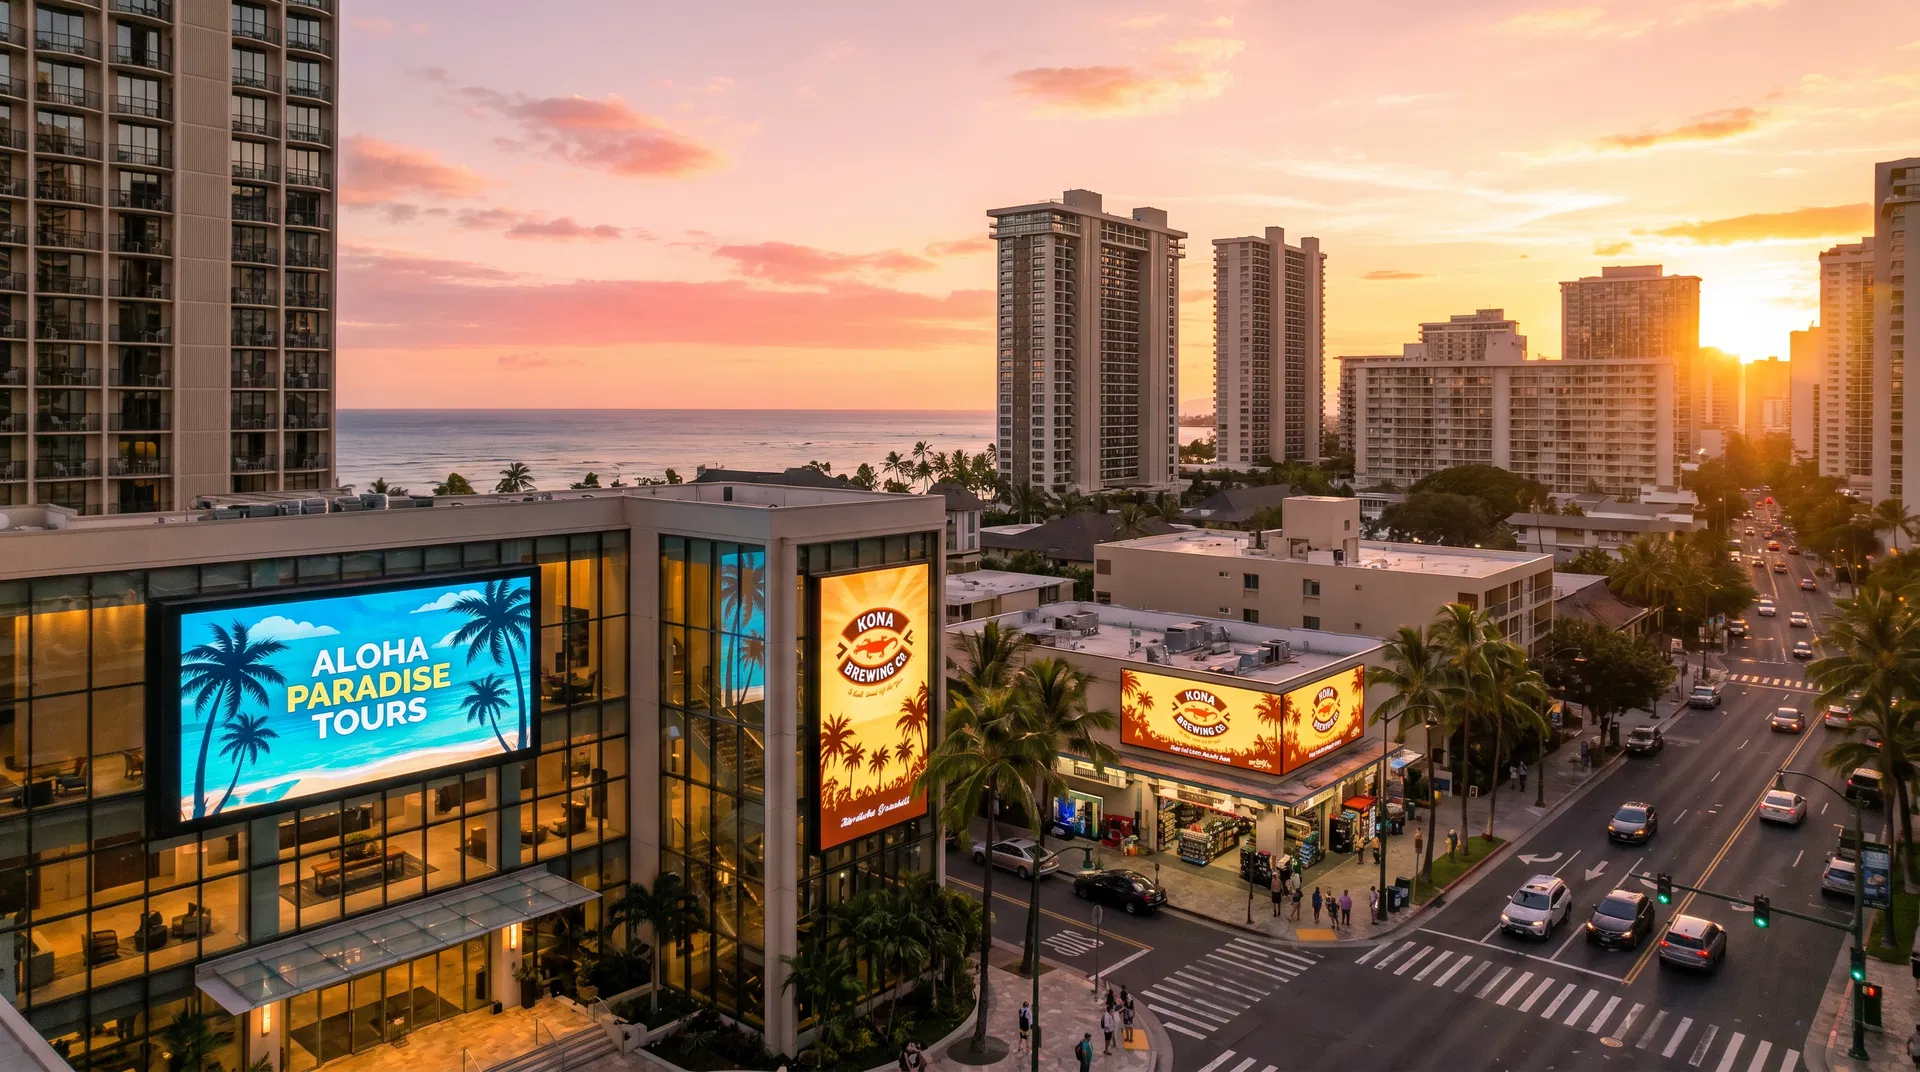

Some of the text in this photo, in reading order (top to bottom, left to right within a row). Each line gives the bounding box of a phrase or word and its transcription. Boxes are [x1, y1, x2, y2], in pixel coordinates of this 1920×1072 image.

[857, 611, 894, 633] KONA
[311, 636, 429, 677] ALOHA
[843, 661, 894, 683] BREWING
[287, 662, 451, 713] PARADISE
[1185, 690, 1215, 706] KONA
[311, 697, 427, 739] TOURS
[1176, 715, 1215, 736] BREWING
